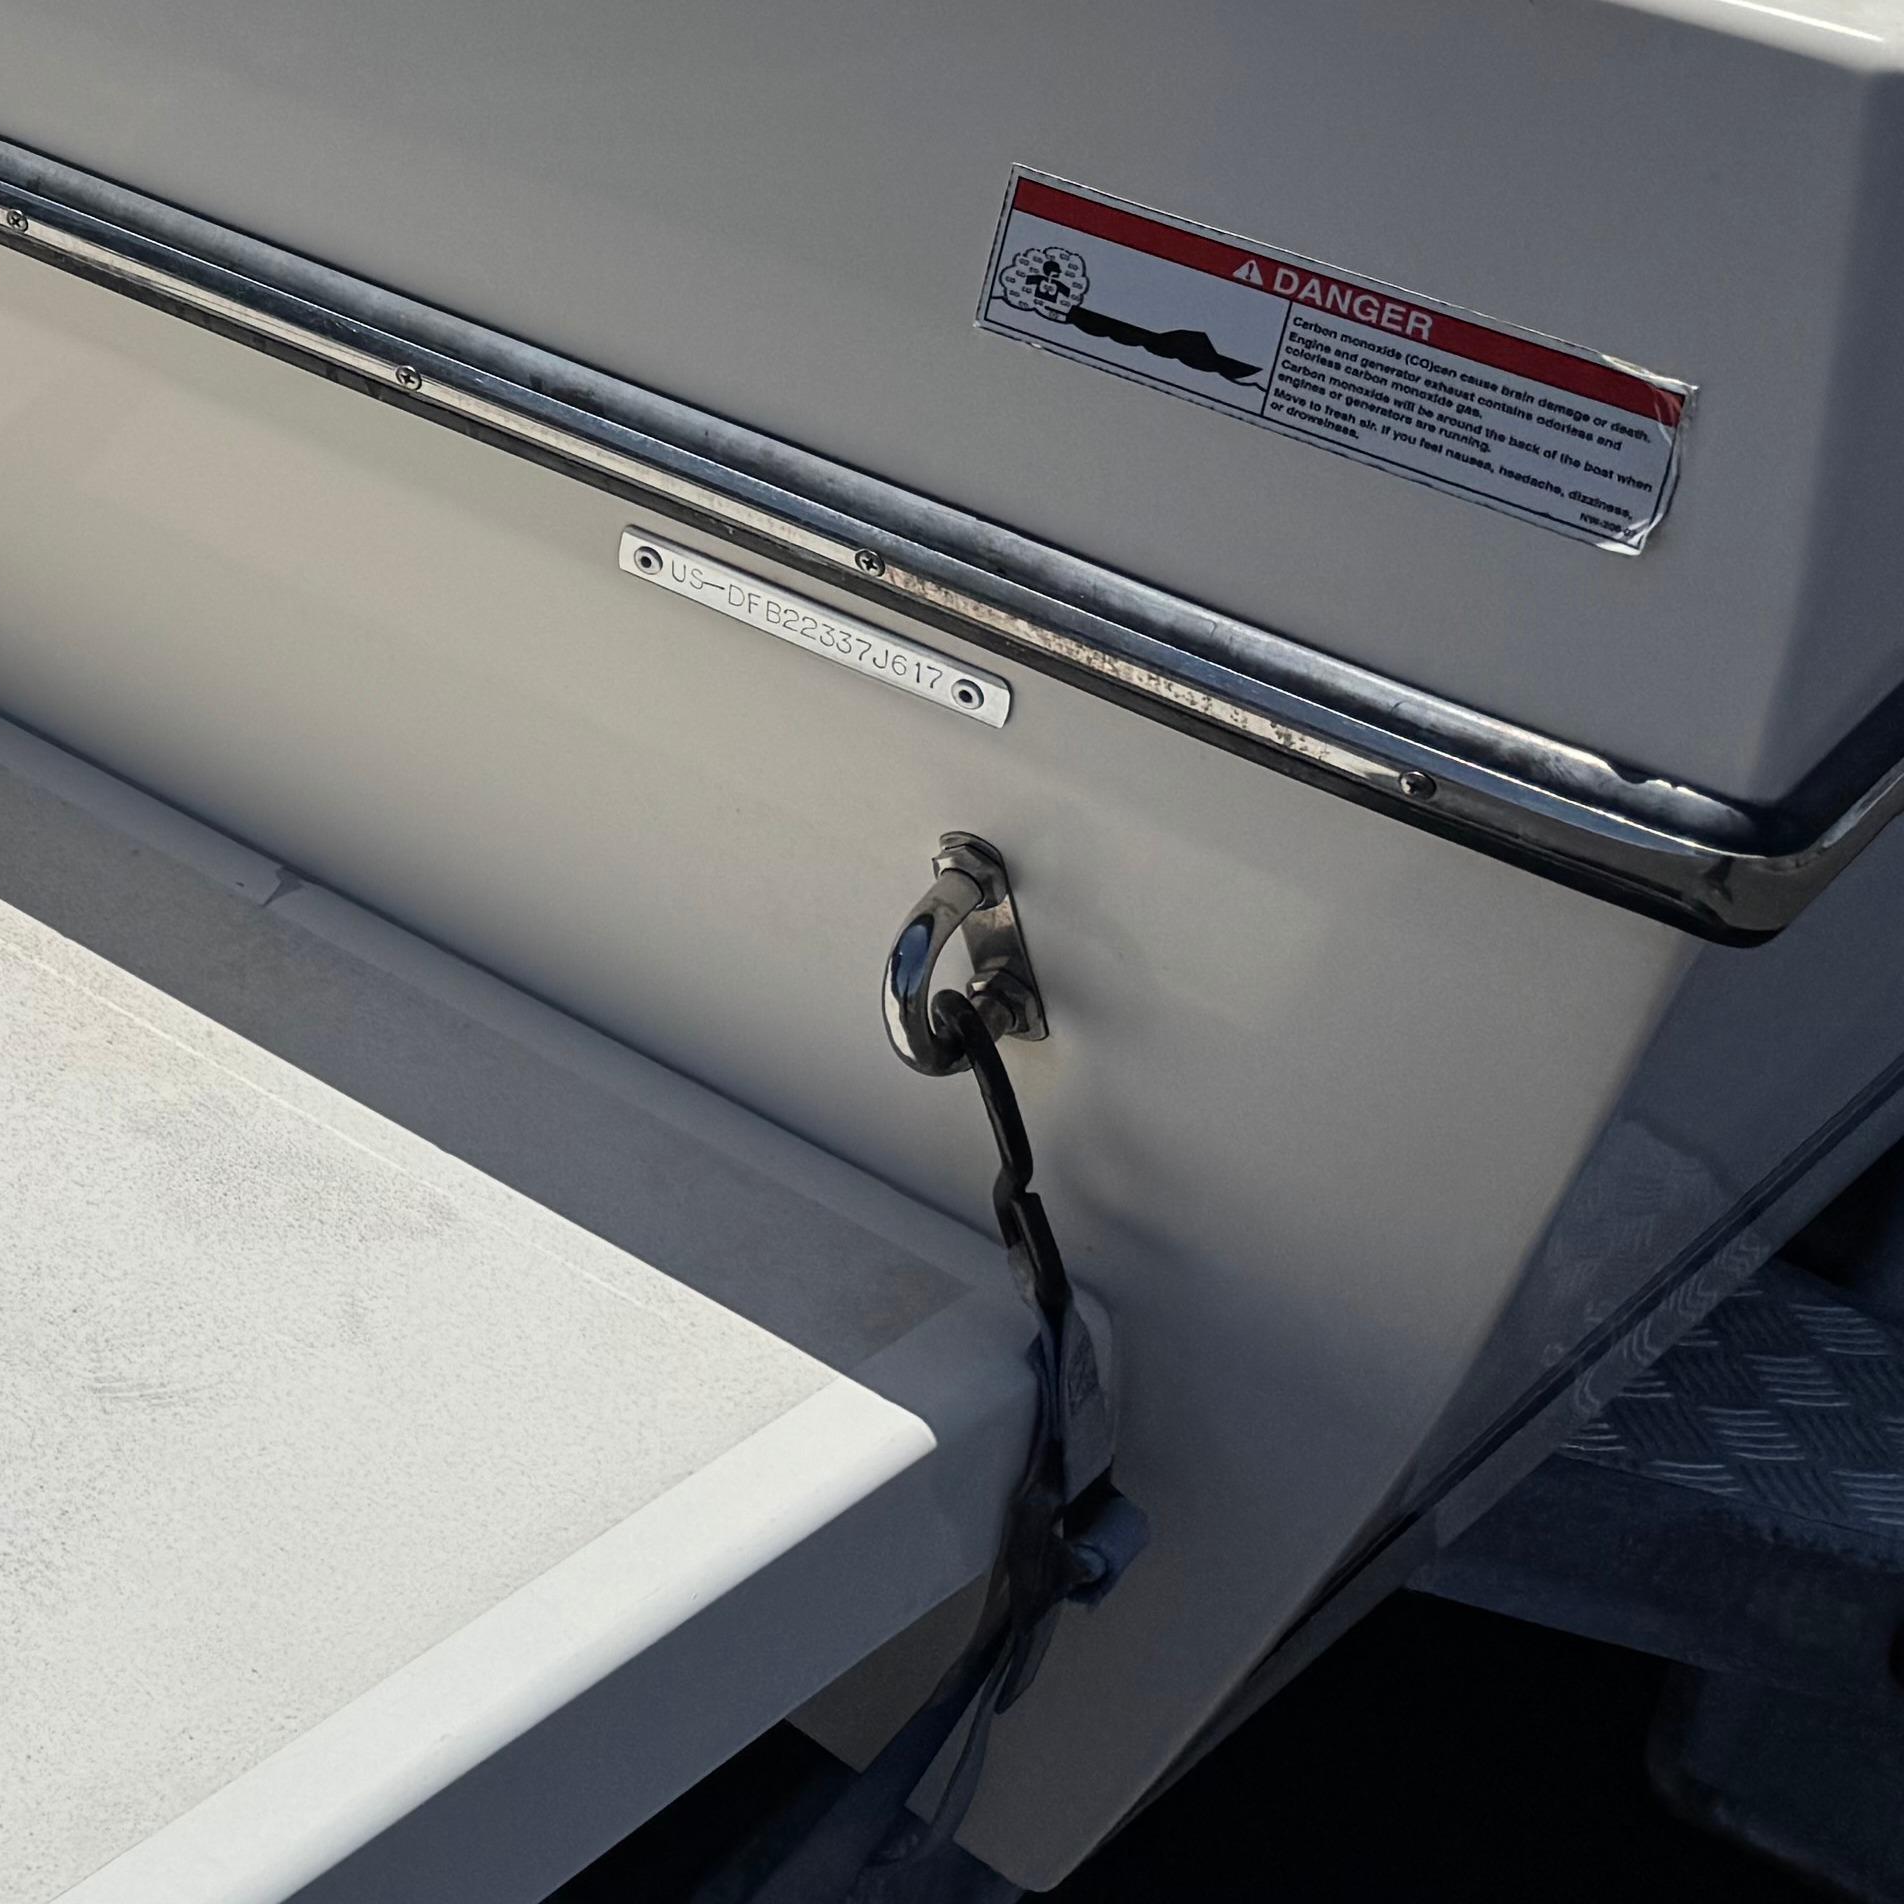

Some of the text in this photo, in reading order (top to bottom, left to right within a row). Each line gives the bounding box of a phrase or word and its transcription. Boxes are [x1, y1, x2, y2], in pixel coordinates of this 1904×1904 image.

[1272, 266, 1434, 341] DANGER
[1269, 401, 1284, 411] or
[1277, 373, 1491, 453] engines or generators are running.
[1280, 359, 1652, 492] Carbon monoxide will be around the back of the boat when
[1284, 345, 1482, 419] colorless carbon monoxide gas.
[1288, 331, 1622, 451] Engine and generator exhaust contains odorless and
[1292, 316, 1337, 339] Carbon
[1339, 333, 1402, 360] monoxide
[1459, 373, 1498, 392] cause
[1500, 385, 1534, 403] brain
[1537, 398, 1590, 422] damage
[1592, 416, 1608, 427] or
[1273, 387, 1633, 521] Move to fresh air. If you feel nausea, headache, dizziness,
[670, 558, 944, 689] US-DFB22337J617
